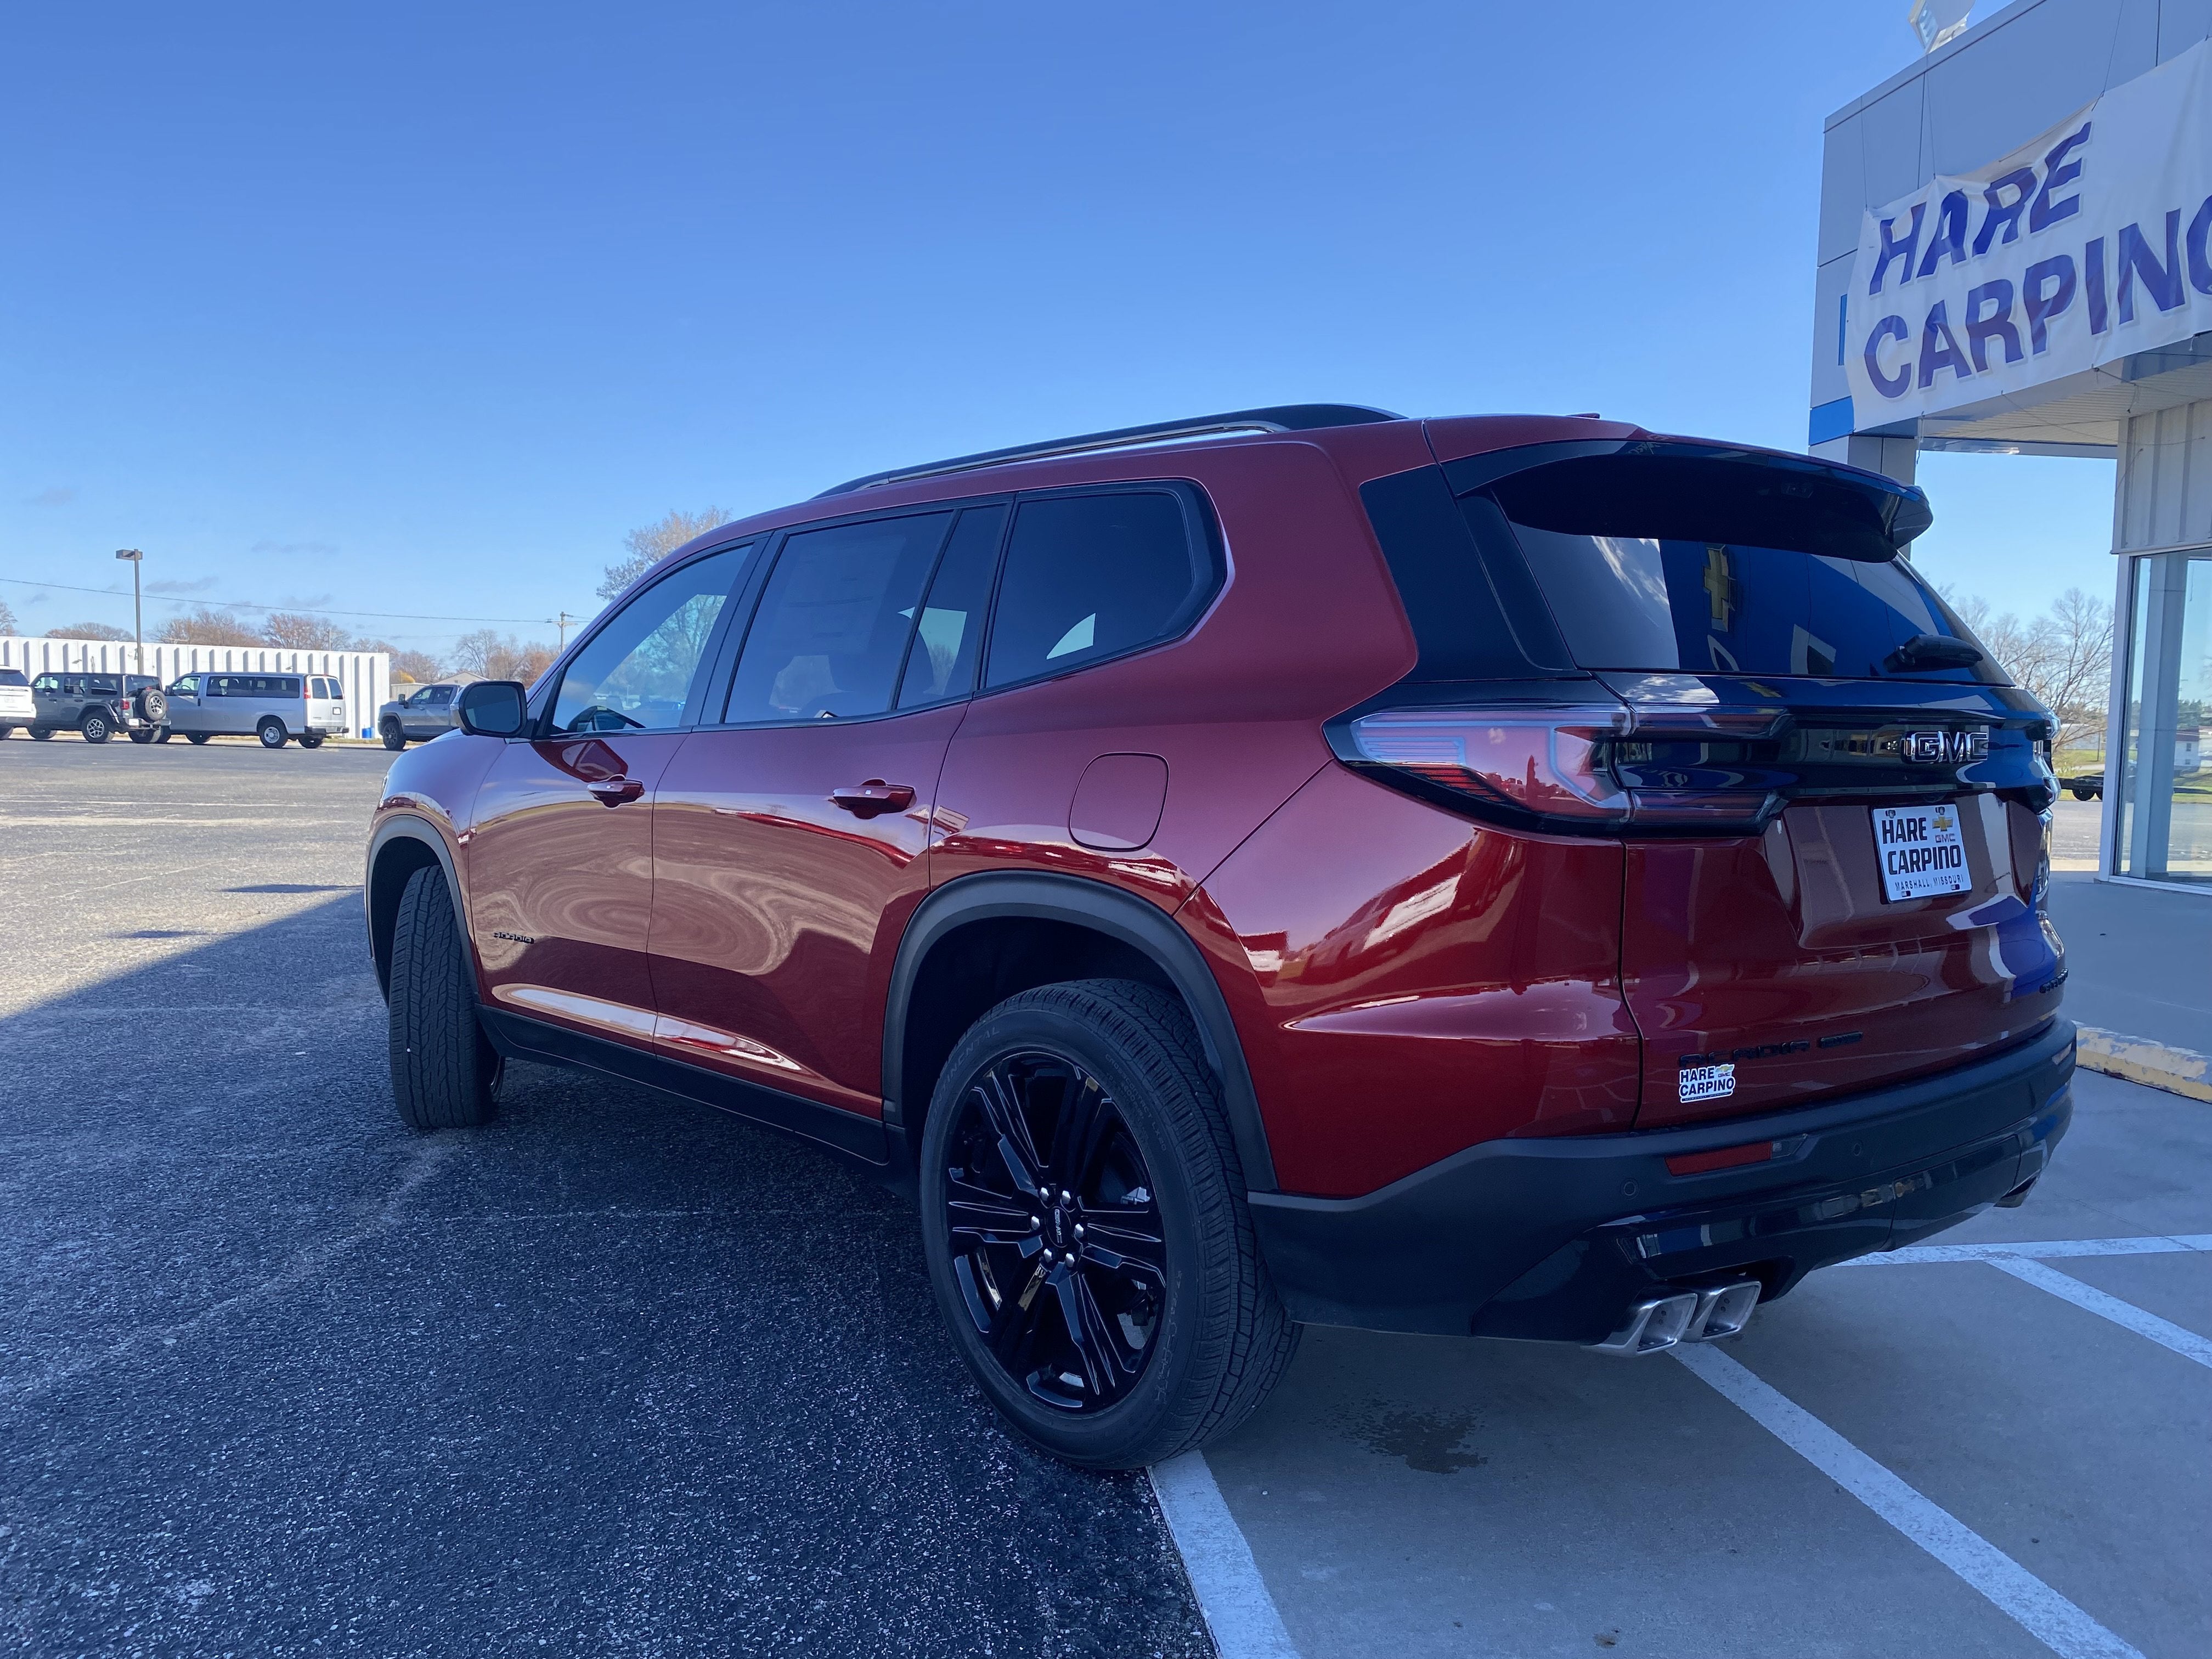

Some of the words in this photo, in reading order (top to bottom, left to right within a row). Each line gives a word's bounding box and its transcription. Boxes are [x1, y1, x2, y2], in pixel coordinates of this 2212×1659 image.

[1869, 121, 2091, 295] HARE
[1903, 731, 1989, 764] GMC
[1882, 817, 1927, 844] HARE
[1934, 833, 1956, 843] GMC
[1887, 845, 1962, 875] CARPINO
[1933, 874, 1964, 887] MISSOURI
[1680, 1067, 1714, 1083] HARE
[1680, 1077, 1734, 1096] CARPINO
